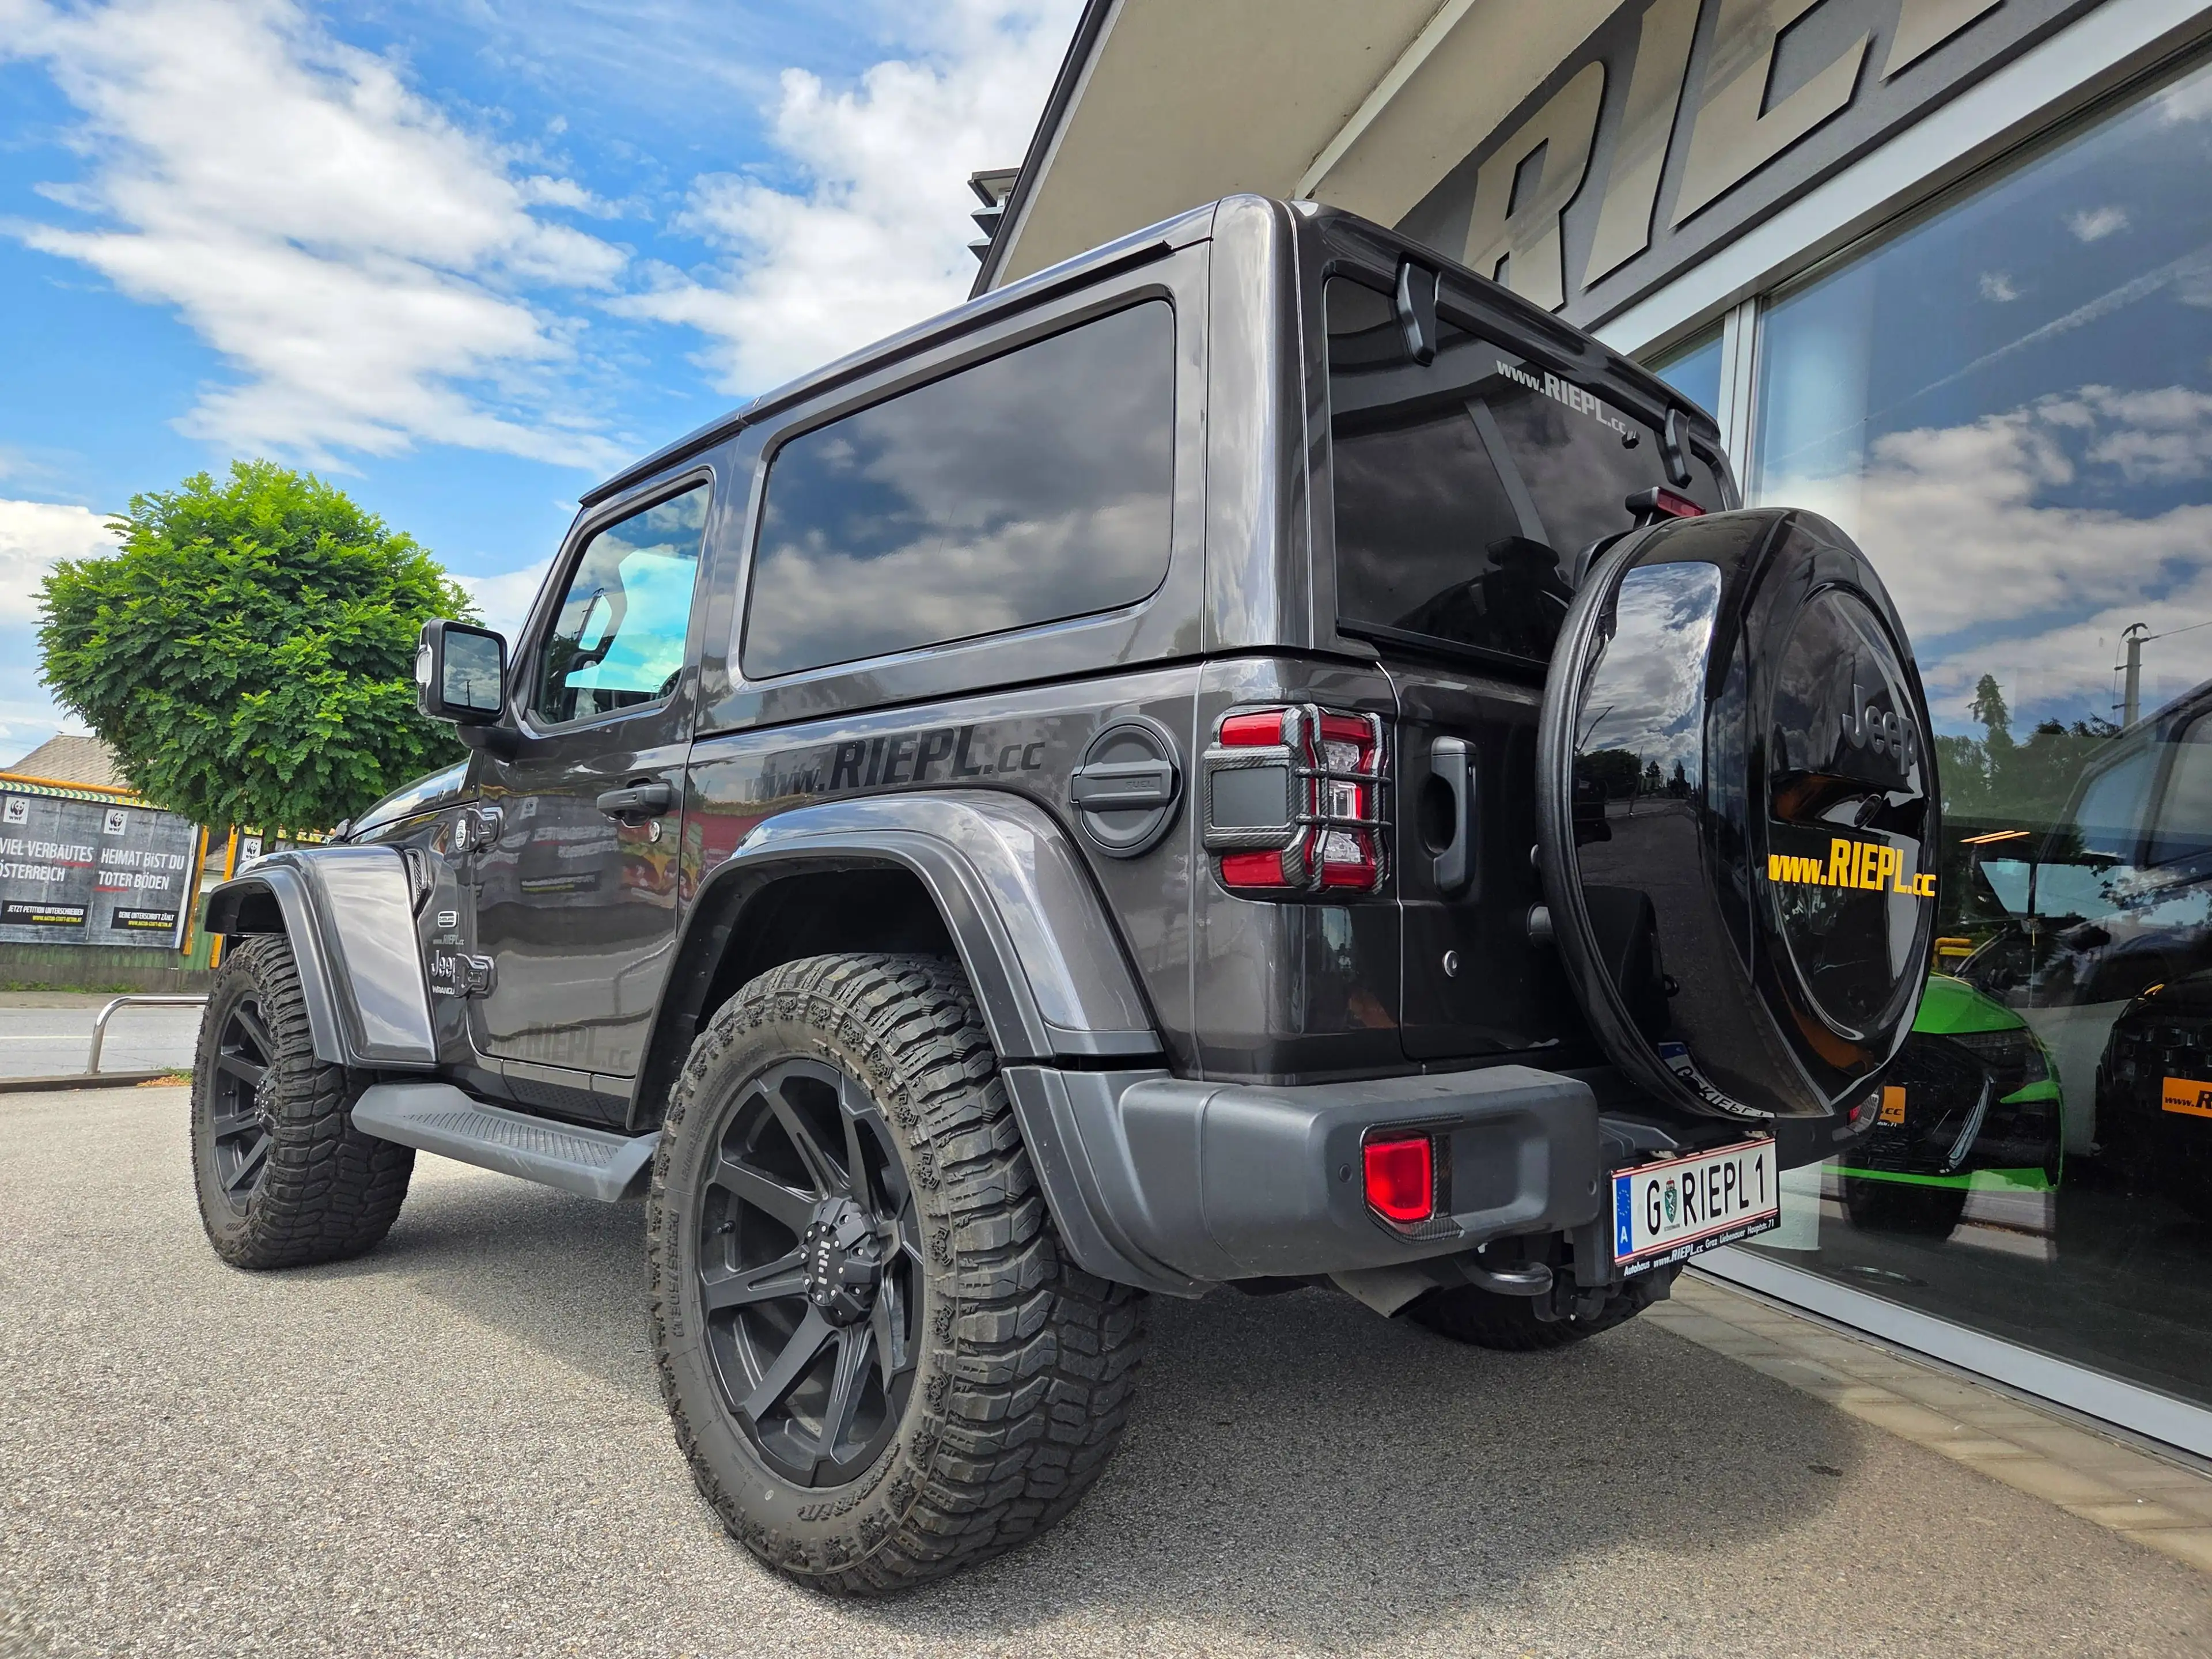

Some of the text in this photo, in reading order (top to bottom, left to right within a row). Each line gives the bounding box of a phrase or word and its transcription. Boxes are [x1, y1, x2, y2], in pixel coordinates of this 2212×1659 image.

[1496, 361, 1626, 435] www.RIEPL.cc
[1842, 684, 1918, 777] Jeep
[744, 724, 1046, 801] www.RIEPL.cc
[0, 838, 94, 862] VIEL VERBAUTES
[101, 848, 143, 866] HEIMAT
[169, 854, 185, 870] DU
[1768, 838, 1937, 897] www.RIEPL.cc
[99, 870, 170, 890] TOTER BÖDEN
[1646, 1153, 1764, 1236] G RIEPL 1
[1620, 1226, 1628, 1244] A
[1624, 1261, 1650, 1277] Autohaus
[1653, 1243, 1703, 1268] www.RIEPL.cc
[1705, 1238, 1717, 1249] Graz
[1719, 1229, 1745, 1244] Liebenauer
